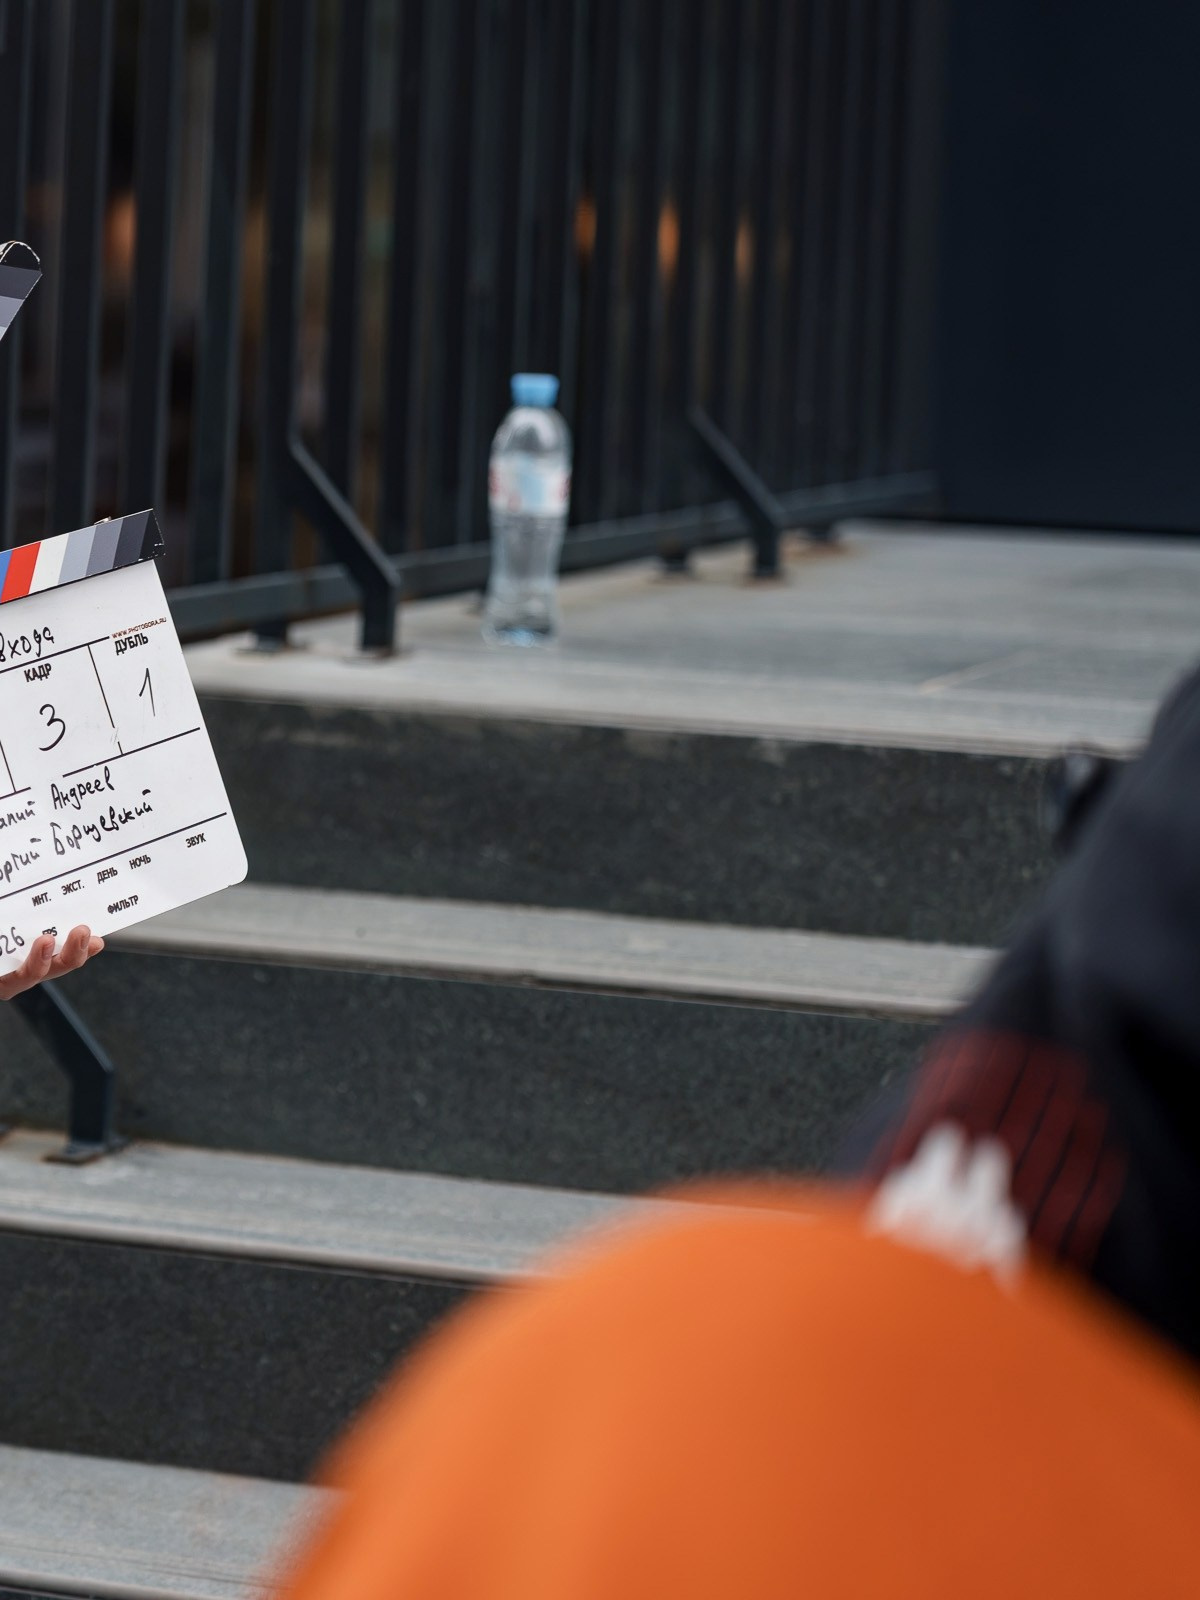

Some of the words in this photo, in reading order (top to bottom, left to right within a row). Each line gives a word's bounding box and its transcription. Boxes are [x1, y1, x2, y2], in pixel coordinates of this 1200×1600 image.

[114, 633, 149, 656] ДУБЛЬ
[24, 663, 52, 682] КАДР
[139, 667, 156, 718] 1
[38, 703, 66, 752] 3
[50, 765, 115, 811] Андреев
[31, 892, 52, 908] ИНТ.
[61, 879, 85, 896] ЭКСТ.
[97, 867, 118, 884] ДЕНЬ
[129, 854, 152, 870] НОЧЬ
[185, 832, 207, 849] ЗВУК
[107, 894, 139, 915] ФИЛЬТР
